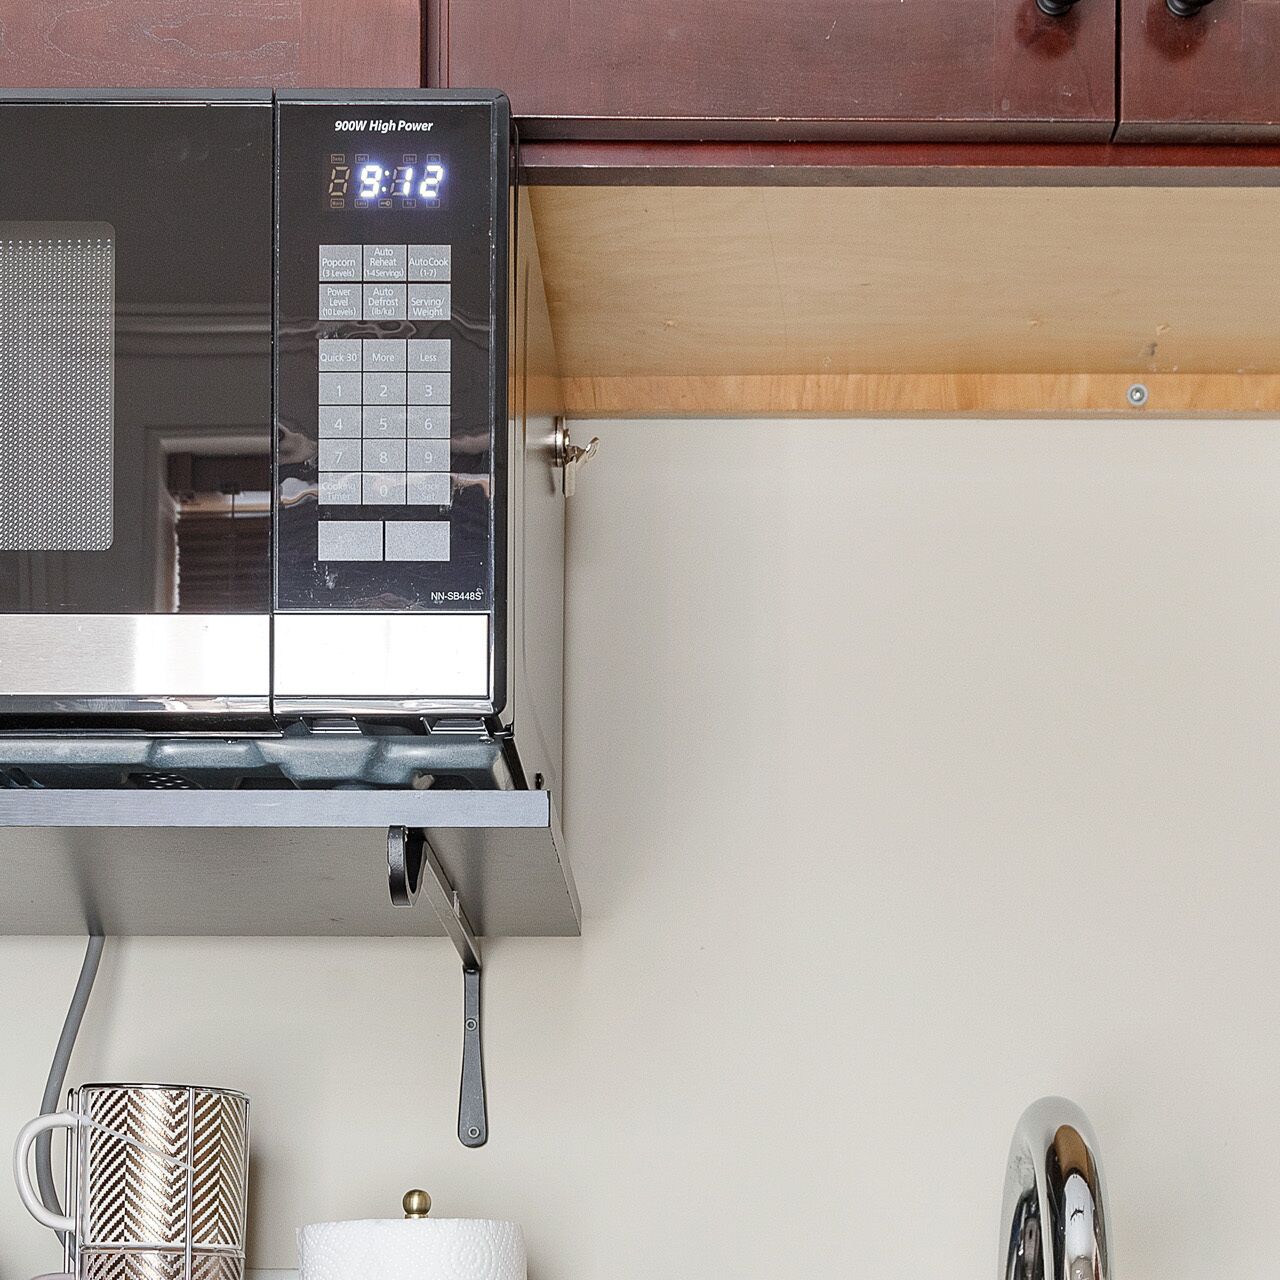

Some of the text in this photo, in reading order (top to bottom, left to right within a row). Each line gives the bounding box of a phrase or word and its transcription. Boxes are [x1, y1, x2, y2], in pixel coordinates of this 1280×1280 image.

[334, 120, 434, 134] 900W High Power
[360, 165, 444, 197] 9:12
[374, 248, 394, 256] Auto
[322, 258, 356, 268] Popcorn
[370, 258, 397, 266] Reheat
[408, 258, 449, 266] Auto Cook
[331, 269, 355, 277] Levels)
[419, 269, 437, 277] (1-7)
[327, 288, 351, 296] Power
[373, 288, 394, 296] Auto
[329, 297, 348, 306] Level
[368, 297, 398, 306] Defrost
[410, 297, 445, 307] Serving/
[332, 308, 356, 316] Levels)
[412, 307, 443, 317] Weight
[320, 353, 357, 362] Quick 30
[372, 353, 395, 362] More
[420, 353, 437, 362] Less
[336, 385, 342, 397] 1
[380, 385, 388, 397] 2
[425, 385, 433, 397] 3
[334, 418, 343, 430] 4
[379, 418, 387, 430] 5
[424, 418, 433, 430] 6
[335, 451, 343, 464] 7
[379, 451, 388, 464] 8
[425, 451, 433, 464] 9
[379, 484, 388, 497] 0
[431, 591, 482, 601] NN-SB448S
